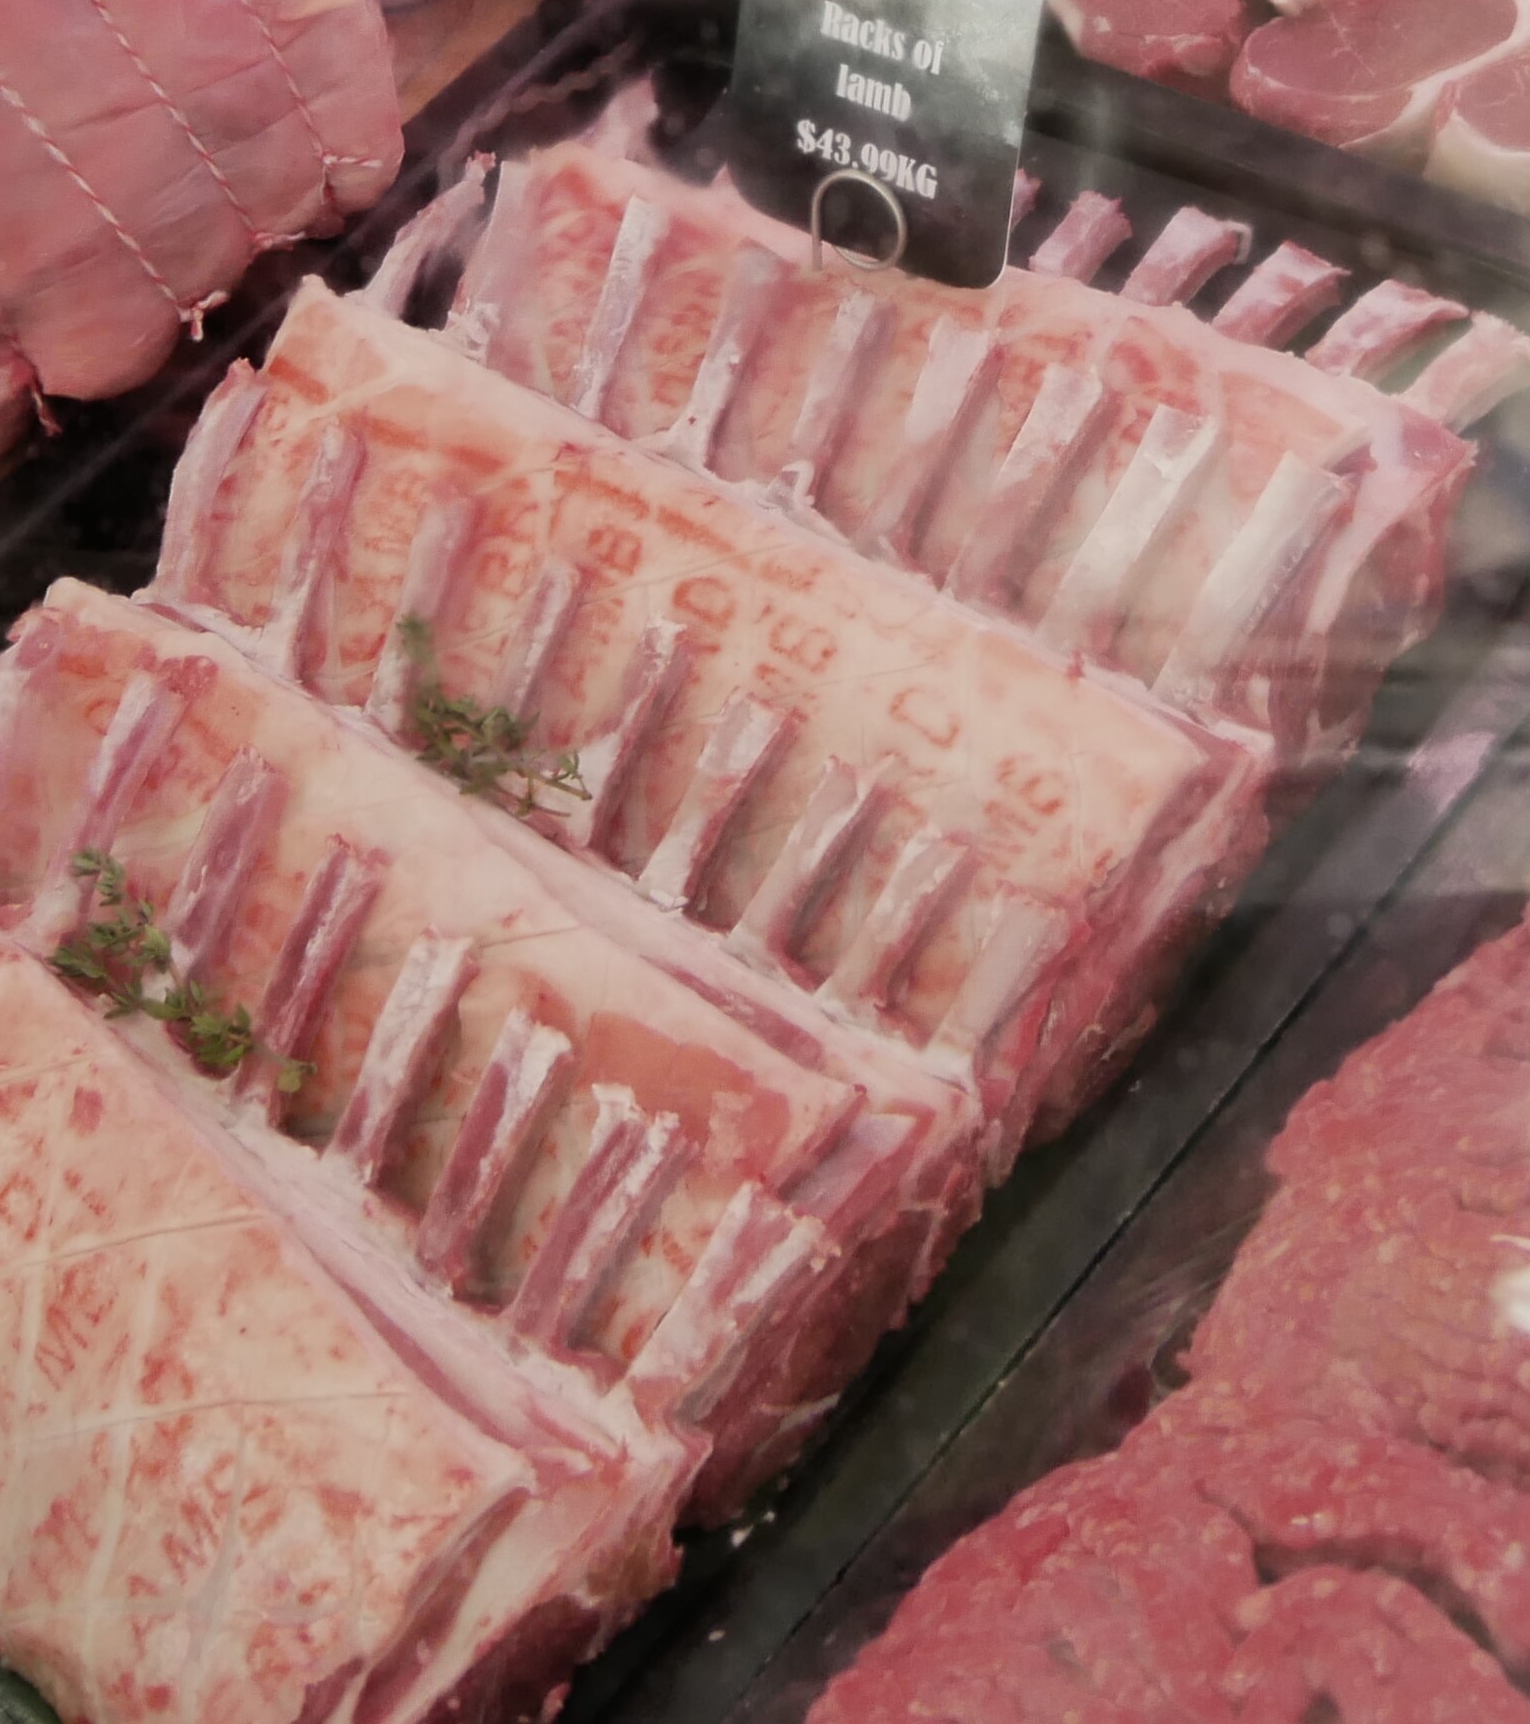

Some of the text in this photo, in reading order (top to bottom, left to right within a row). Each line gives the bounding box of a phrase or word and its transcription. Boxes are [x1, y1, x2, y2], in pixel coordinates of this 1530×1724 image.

[819, 0, 946, 77] Racks of
[835, 63, 913, 123] lamb
[795, 118, 941, 202] $43.99KG
